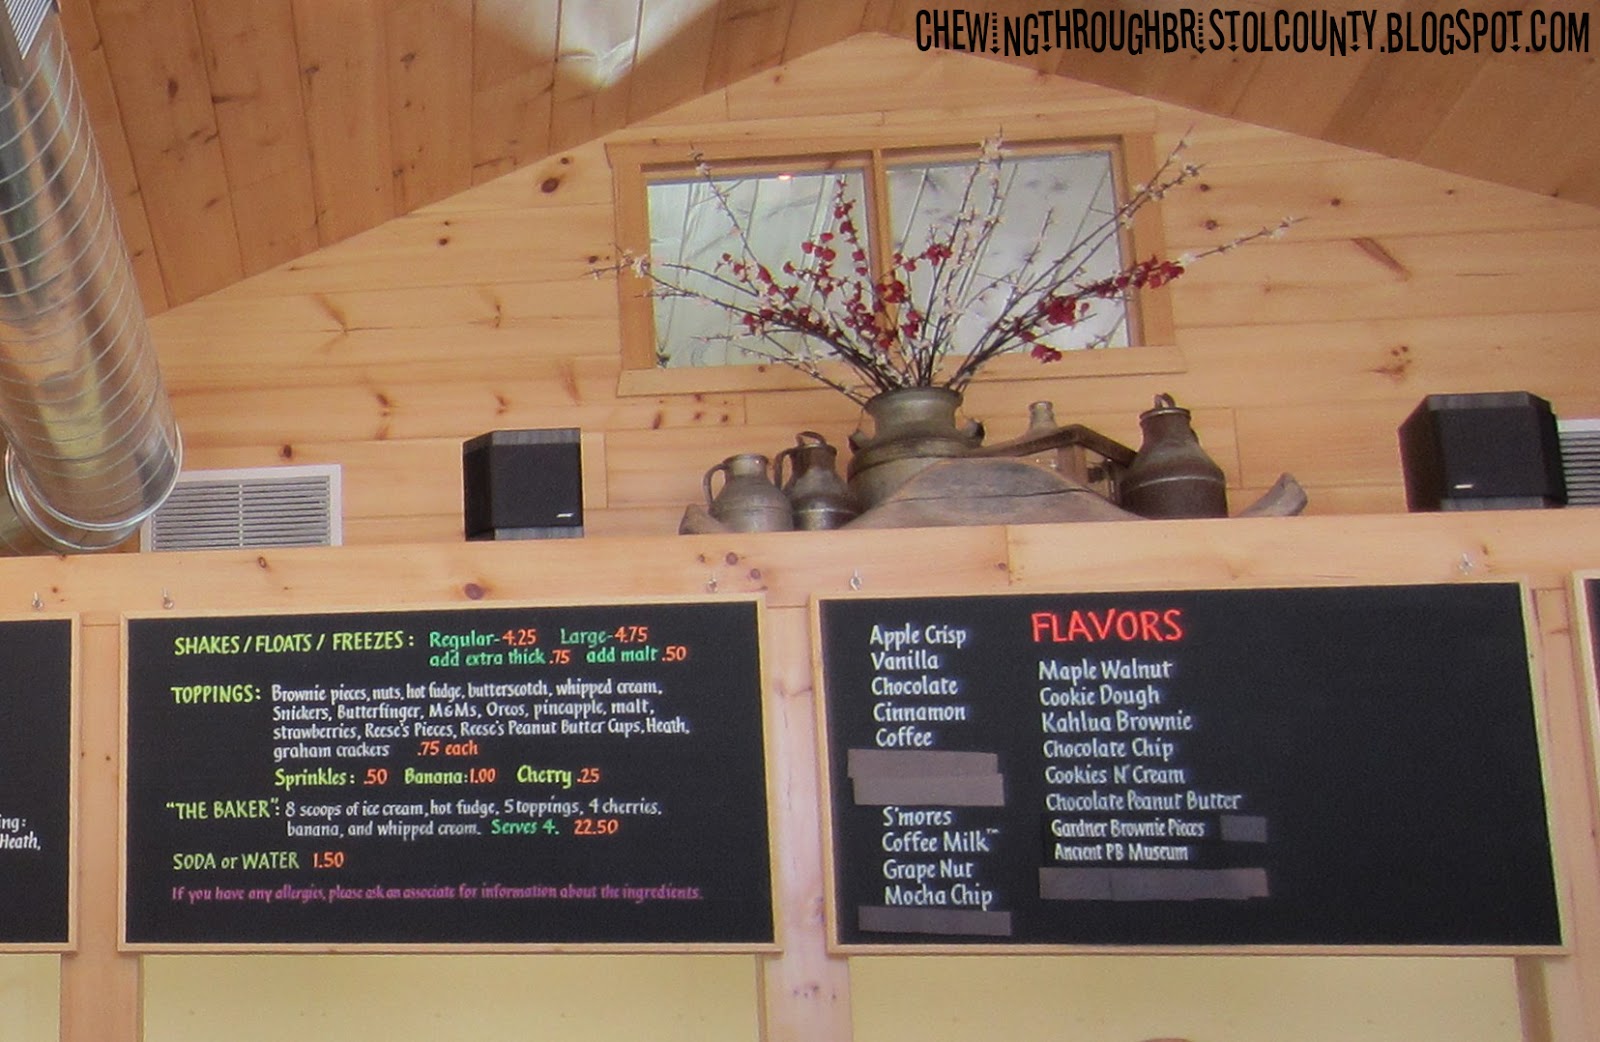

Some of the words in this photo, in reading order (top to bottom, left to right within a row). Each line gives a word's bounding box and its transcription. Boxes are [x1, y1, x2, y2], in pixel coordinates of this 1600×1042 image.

[1031, 608, 1183, 642] FLAVORS
[870, 624, 920, 650] Apple
[924, 624, 966, 649] Crisp
[429, 651, 460, 666] add
[466, 650, 502, 666] extra
[508, 648, 546, 665] thick
[550, 650, 571, 664] .75
[586, 647, 616, 663] add
[621, 645, 658, 662] malt
[661, 646, 687, 662] .50
[871, 650, 938, 670] Vanilla
[1039, 658, 1096, 686] Maple
[1101, 660, 1173, 680] Walnut
[170, 684, 261, 704] TOPPINGS:
[272, 684, 326, 702] Brownie
[406, 682, 426, 698] hot
[556, 678, 612, 699] whipped
[872, 676, 958, 696] Chocolate
[1040, 686, 1095, 707] Cookie
[1100, 685, 1160, 710] Dough
[272, 705, 332, 722] Snickers,
[337, 702, 424, 722] Butterfinger,
[874, 703, 966, 723] Cinnamon
[1042, 712, 1111, 732] Kahlua
[1116, 708, 1193, 731] Brownie
[273, 723, 362, 740] strawberries,
[364, 723, 410, 738] Reese's
[460, 720, 504, 736] Reese's
[508, 720, 557, 735] Peanut
[561, 719, 606, 734] Butter
[876, 727, 932, 748] Coffee
[273, 742, 331, 762] graham
[336, 742, 390, 758] crackers
[417, 741, 440, 756] .75
[445, 739, 478, 756] each
[1043, 738, 1127, 758] Chocolate
[1132, 737, 1174, 762] Chip
[364, 769, 388, 784] .50
[516, 765, 572, 789] Cherry
[576, 768, 600, 784] .25
[1045, 764, 1107, 784] Cookies
[1132, 765, 1186, 784] Cream
[285, 802, 295, 816] 8
[300, 803, 342, 820] scoops
[346, 802, 360, 816] of
[362, 801, 380, 816] ice
[430, 799, 452, 814] hot
[504, 799, 514, 814] 5
[588, 798, 598, 814] 4
[1046, 790, 1124, 811] Chocolate
[1128, 790, 1183, 810] Peanut
[1187, 790, 1242, 810] Butter
[0, 813, 26, 833] ng:
[882, 806, 952, 826] S'mores
[1110, 817, 1165, 836] Brownie
[348, 821, 373, 836] and
[377, 820, 434, 841] whipped
[491, 818, 538, 834] Serves
[574, 819, 619, 835] 22.50
[882, 832, 938, 852] Coffee
[1106, 844, 1124, 861] PB
[1129, 843, 1188, 861] Museum
[173, 852, 216, 870] SODA
[221, 854, 238, 870] or
[242, 852, 300, 870] WATER
[313, 852, 344, 868] 1.50
[883, 858, 936, 883] Grape
[940, 859, 974, 878] Nut
[172, 886, 184, 900] If
[188, 888, 211, 904] you
[216, 886, 244, 900] have
[248, 888, 272, 904] any
[329, 884, 362, 903] please
[366, 885, 385, 899] ask
[386, 888, 401, 899] an
[403, 884, 455, 899] associate
[460, 883, 478, 899] for
[482, 882, 557, 899] information
[560, 884, 598, 899] about
[601, 884, 620, 898] the
[884, 884, 946, 906] Mocha
[951, 883, 993, 912] Chip
